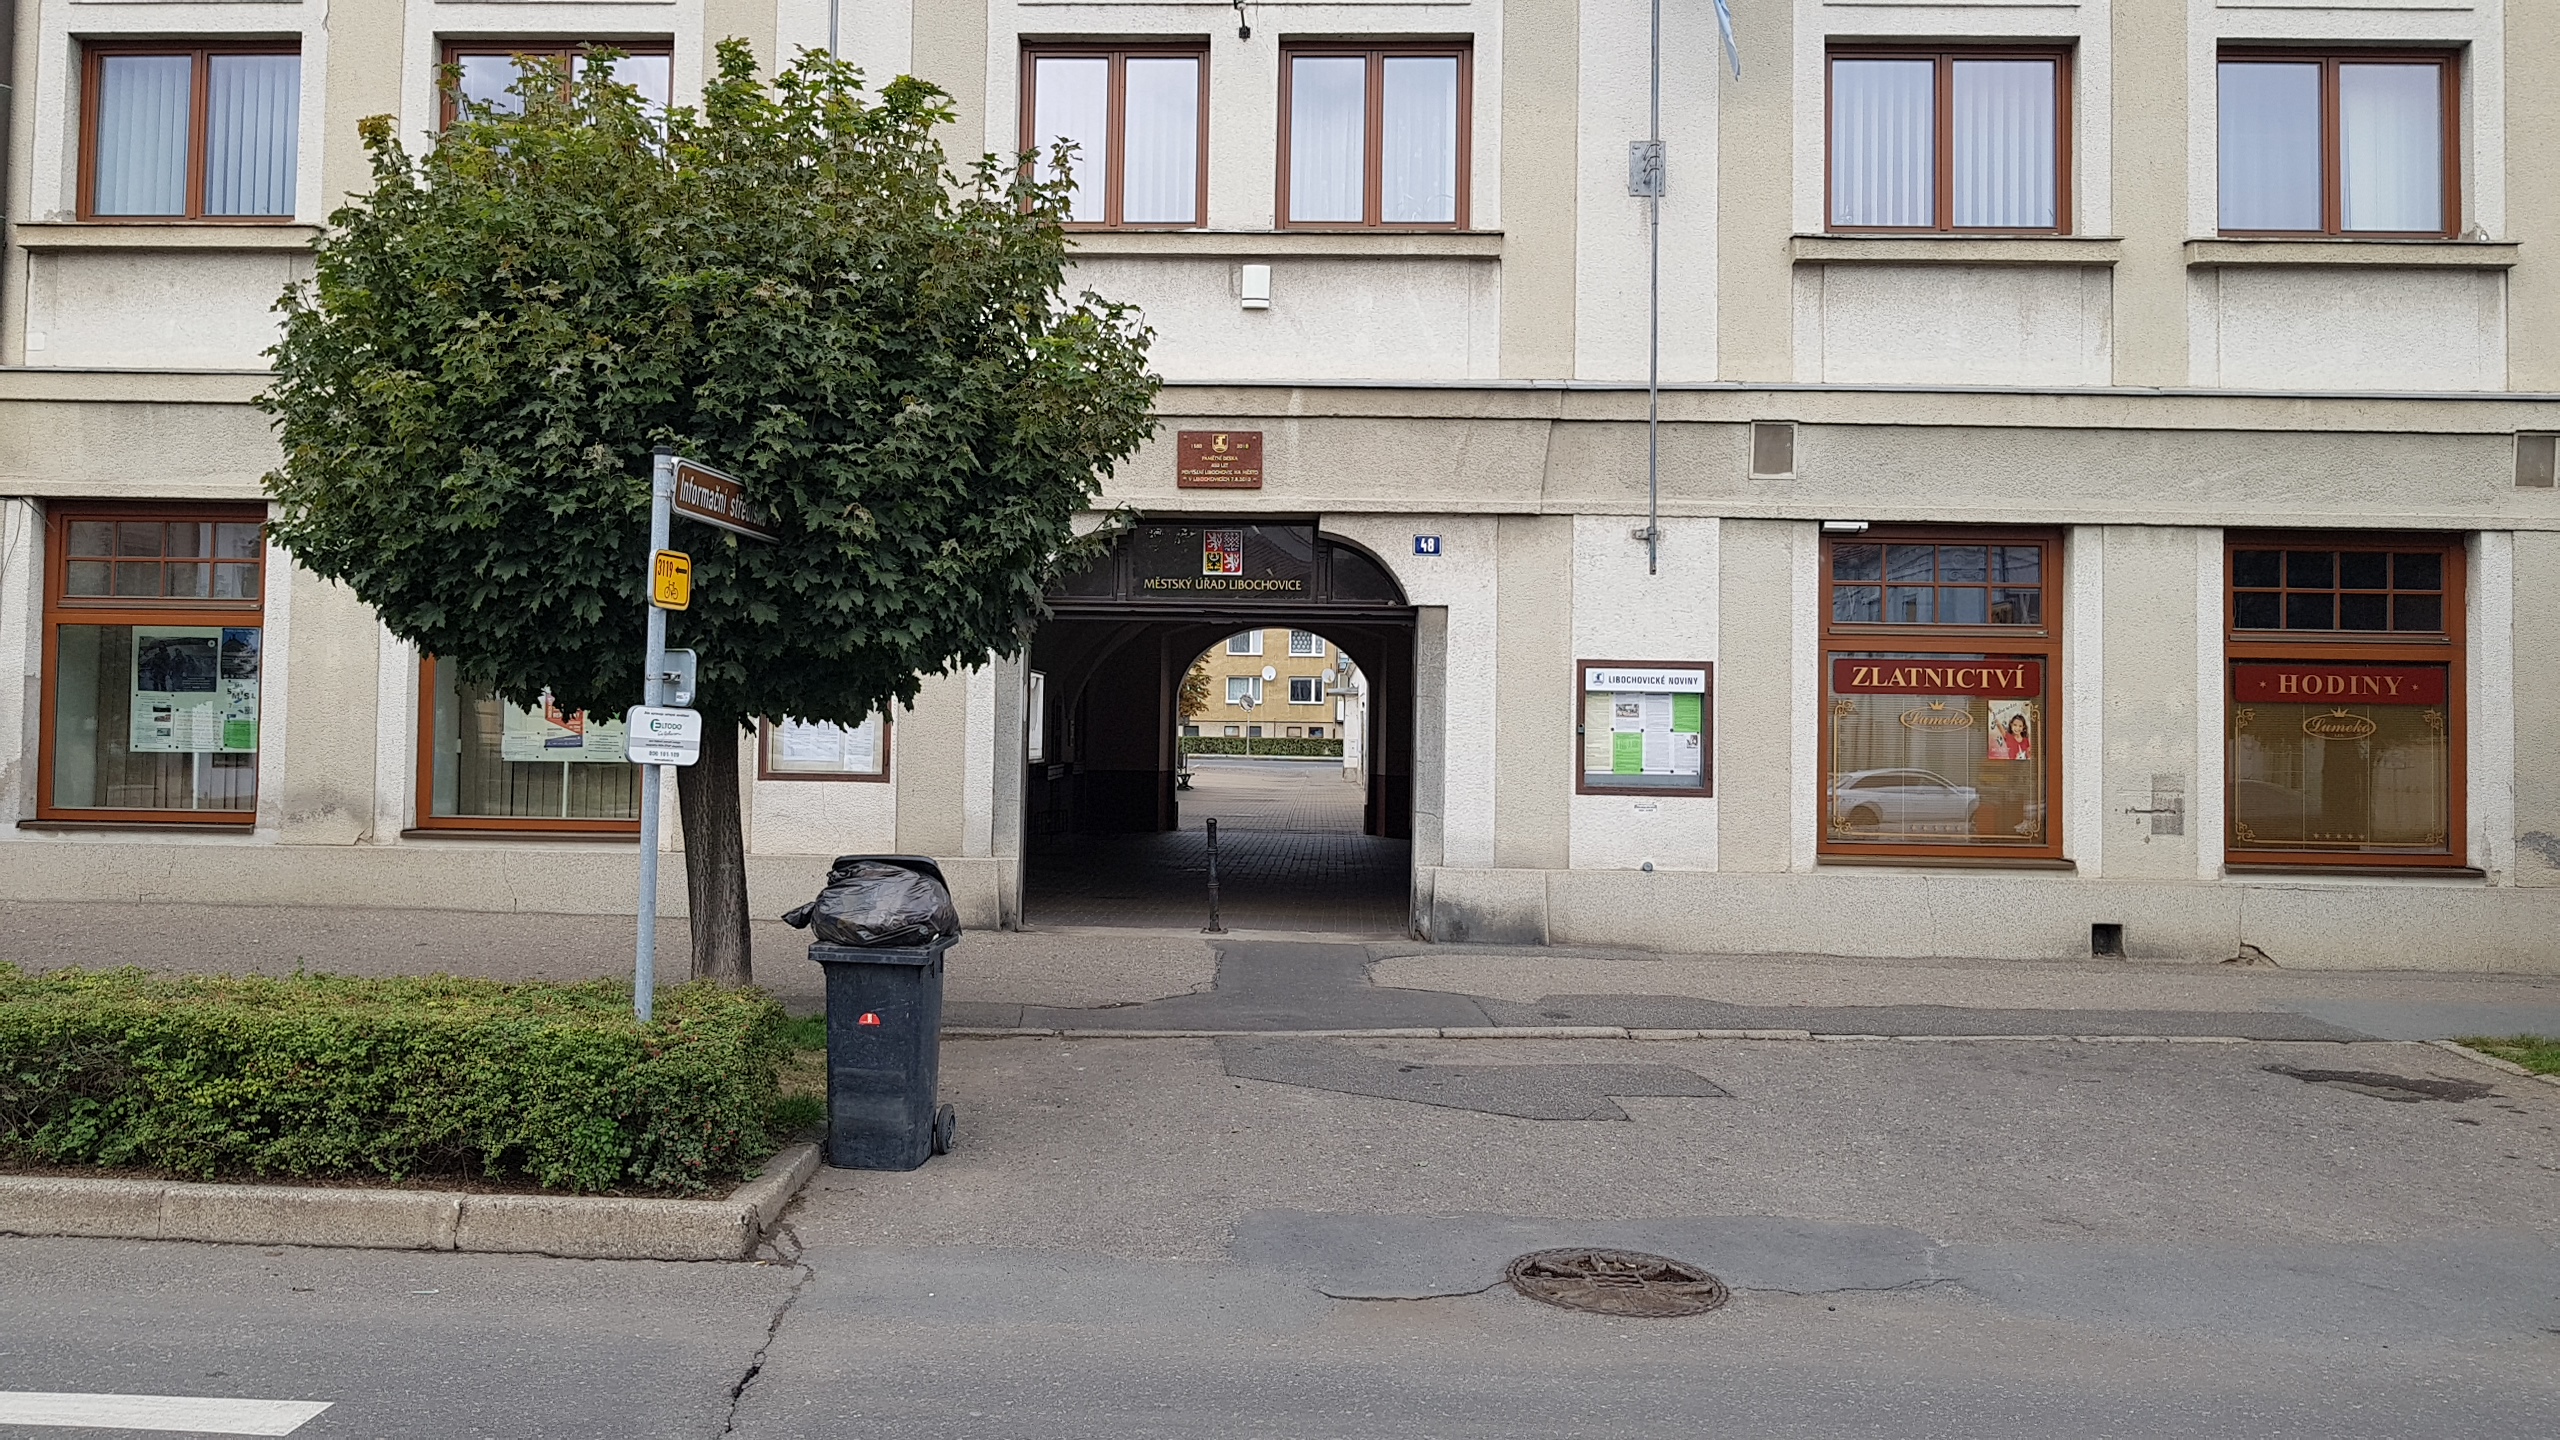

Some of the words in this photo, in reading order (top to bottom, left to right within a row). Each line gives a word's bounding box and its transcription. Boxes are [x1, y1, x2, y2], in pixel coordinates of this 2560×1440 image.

[679, 472, 729, 515] Informační
[1420, 537, 1435, 552] 48
[657, 558, 674, 578] 3119
[1143, 576, 1193, 589] MĚSTSKÝ
[1195, 577, 1226, 590] ÚŘAD
[1229, 579, 1302, 591] LIBOCHOVICE
[1608, 675, 1665, 685] LIBOCHOVICKÉ
[1668, 677, 1698, 685] NOVINY
[1851, 664, 2025, 689] ZLATNICTVÍ
[2277, 673, 2403, 696] HODINY
[1907, 711, 1969, 726] Lumeko
[2309, 718, 2370, 733] Lumeko
